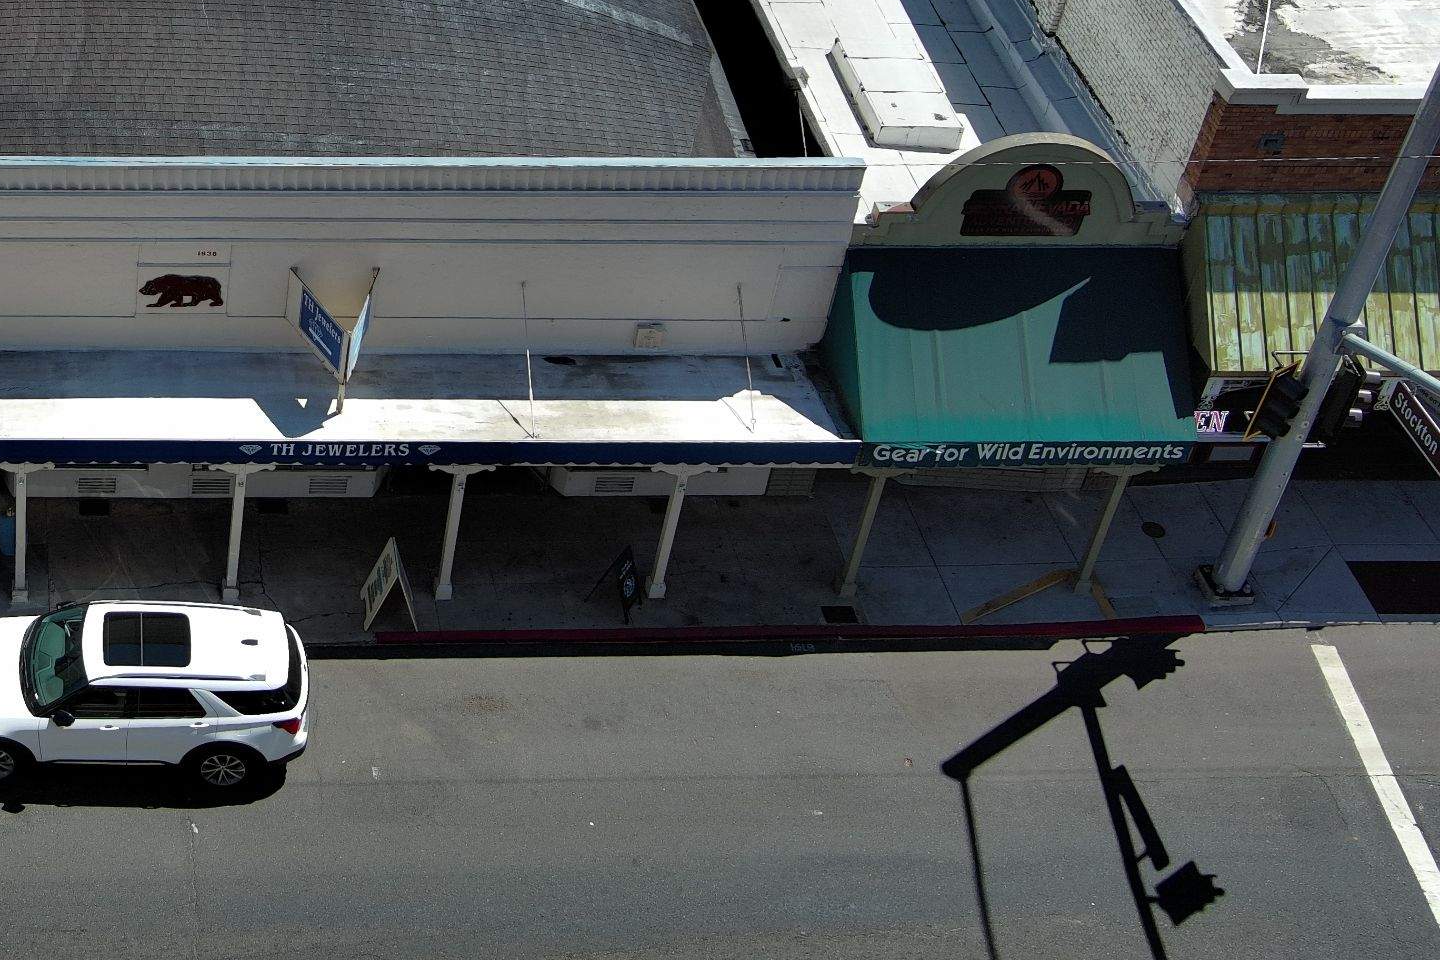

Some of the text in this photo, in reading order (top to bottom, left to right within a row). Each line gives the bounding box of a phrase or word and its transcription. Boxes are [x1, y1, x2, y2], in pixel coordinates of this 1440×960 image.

[303, 293, 341, 344] TH Jewelers
[1394, 392, 1438, 455] Stockton
[270, 443, 410, 457] TH JEWELERS
[873, 443, 1184, 461] Gear for Wild Environments
